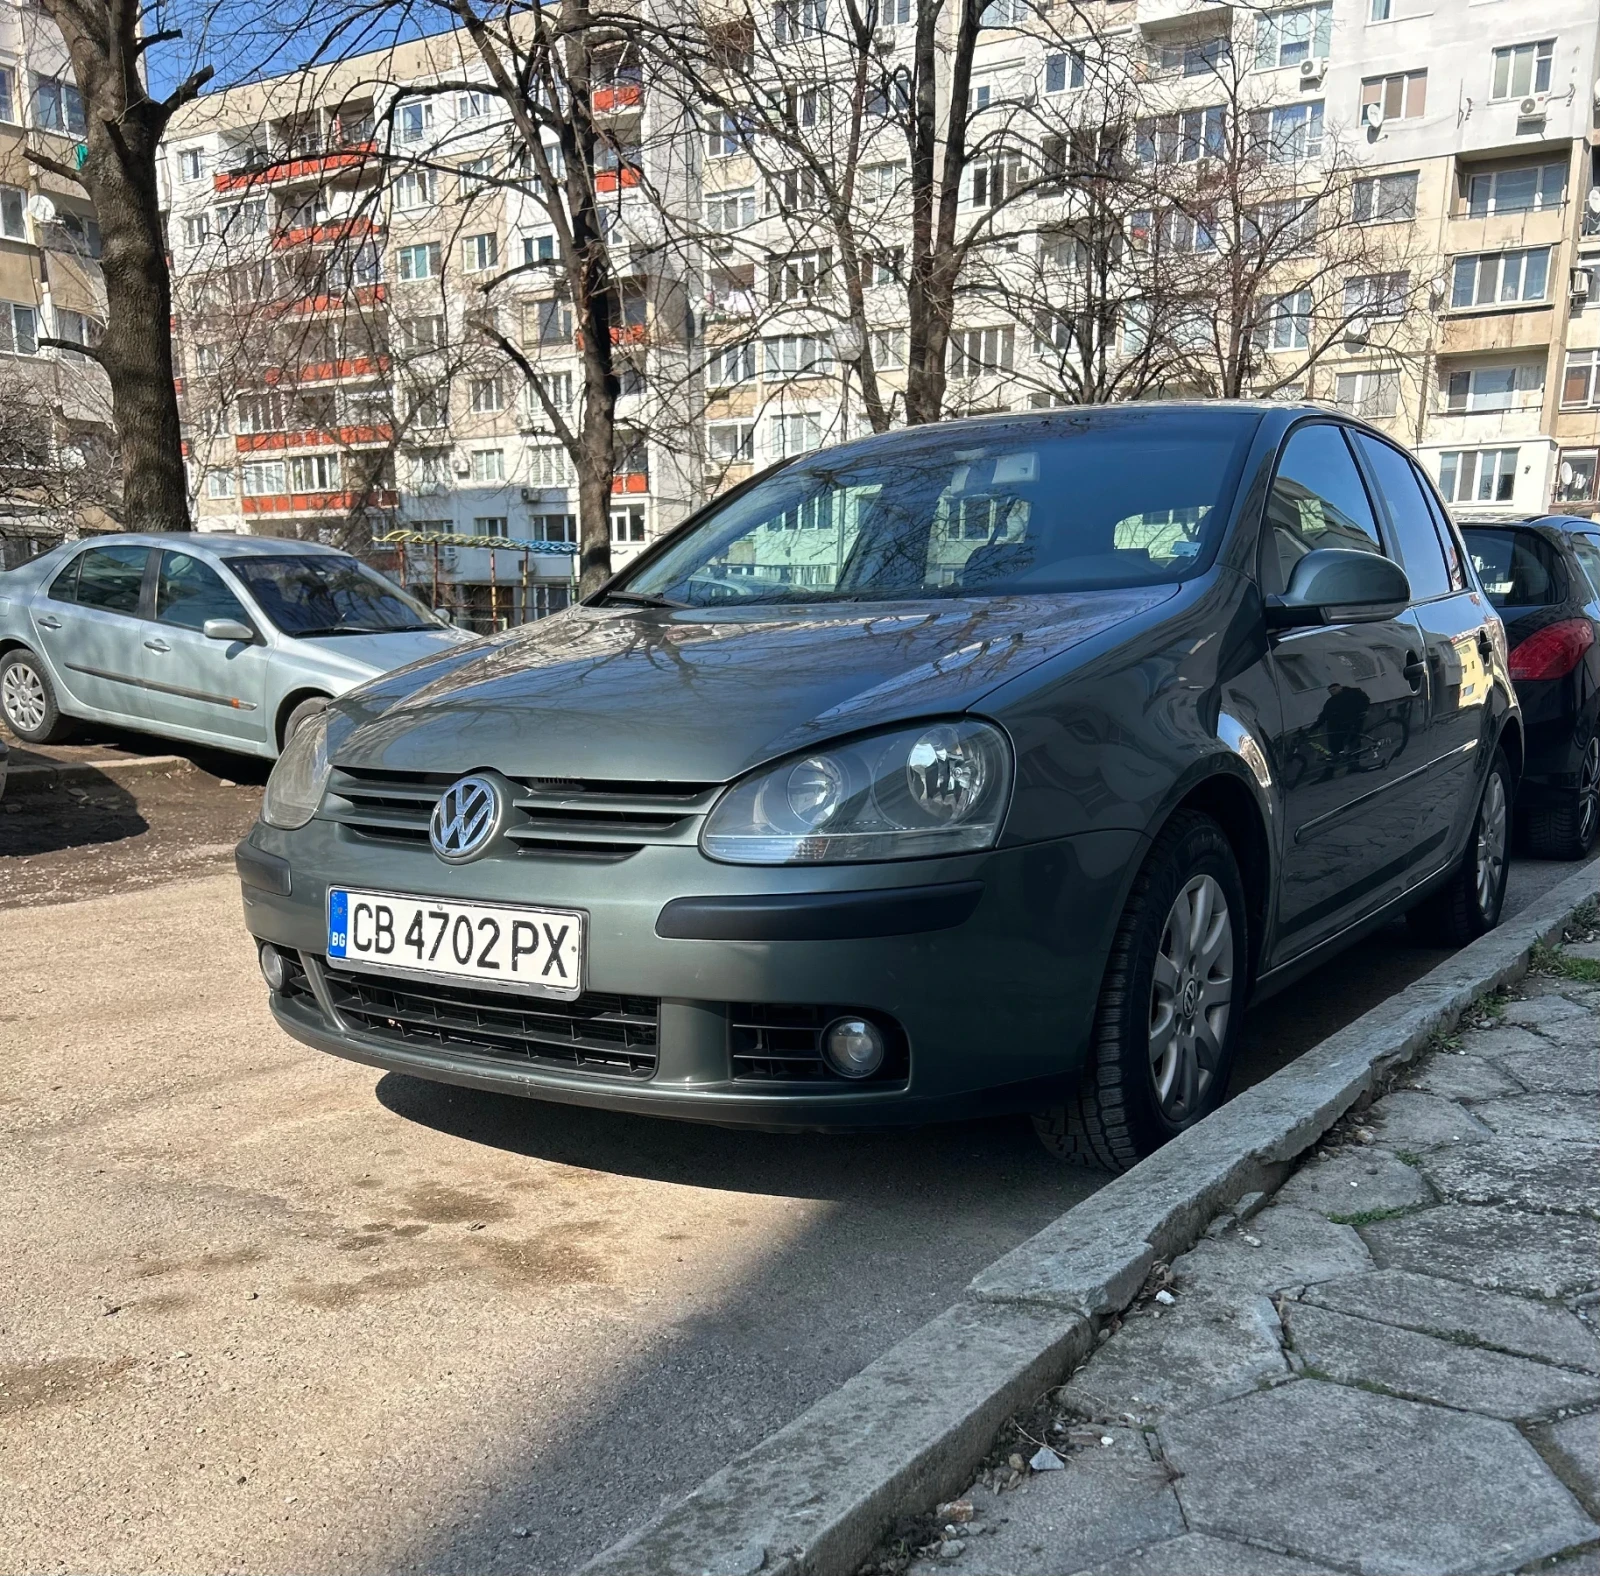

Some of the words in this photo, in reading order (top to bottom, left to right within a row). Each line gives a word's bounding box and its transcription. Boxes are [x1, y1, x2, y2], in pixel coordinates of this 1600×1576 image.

[432, 780, 498, 855] VW
[331, 931, 346, 947] BG
[353, 902, 396, 954] CB
[405, 909, 501, 970] 4702
[511, 919, 569, 978] PX
